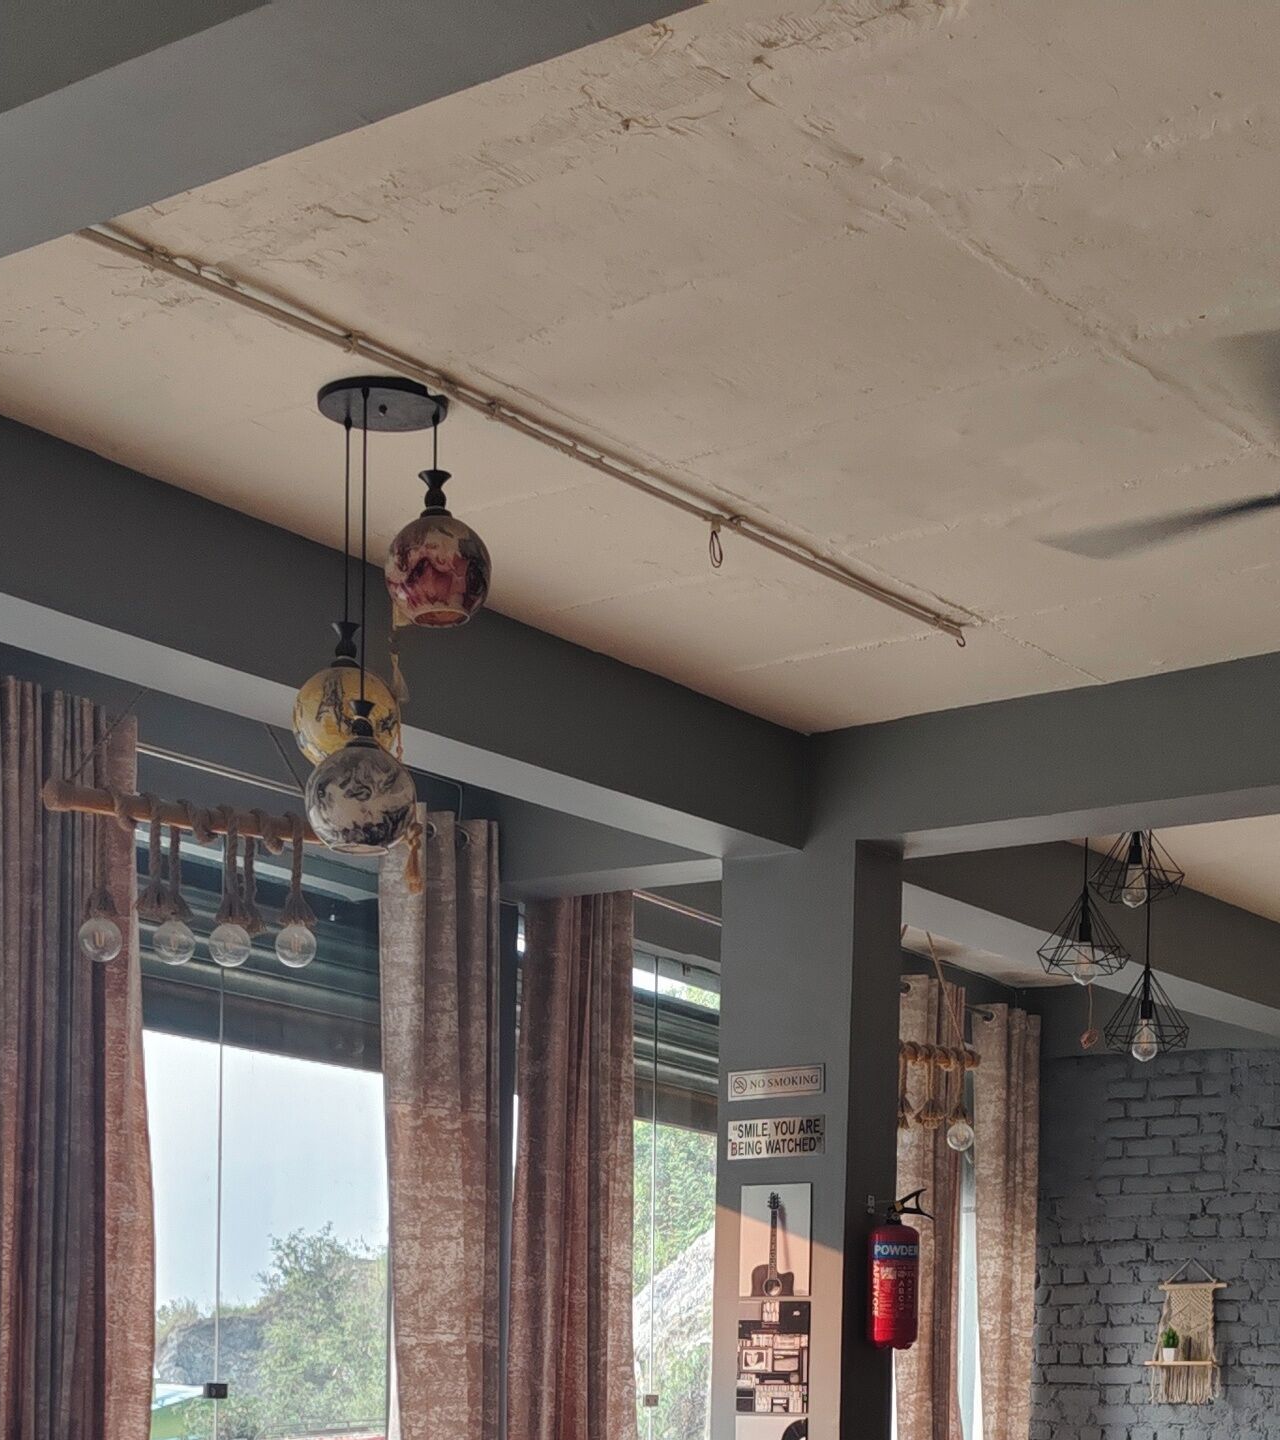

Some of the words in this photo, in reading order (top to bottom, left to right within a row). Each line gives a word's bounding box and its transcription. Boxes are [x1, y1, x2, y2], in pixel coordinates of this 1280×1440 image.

[750, 1079, 765, 1089] NO
[767, 1074, 819, 1088] SMOKING
[773, 1120, 796, 1136] YOU
[797, 1118, 820, 1135] ARE
[730, 1140, 762, 1156] BEING
